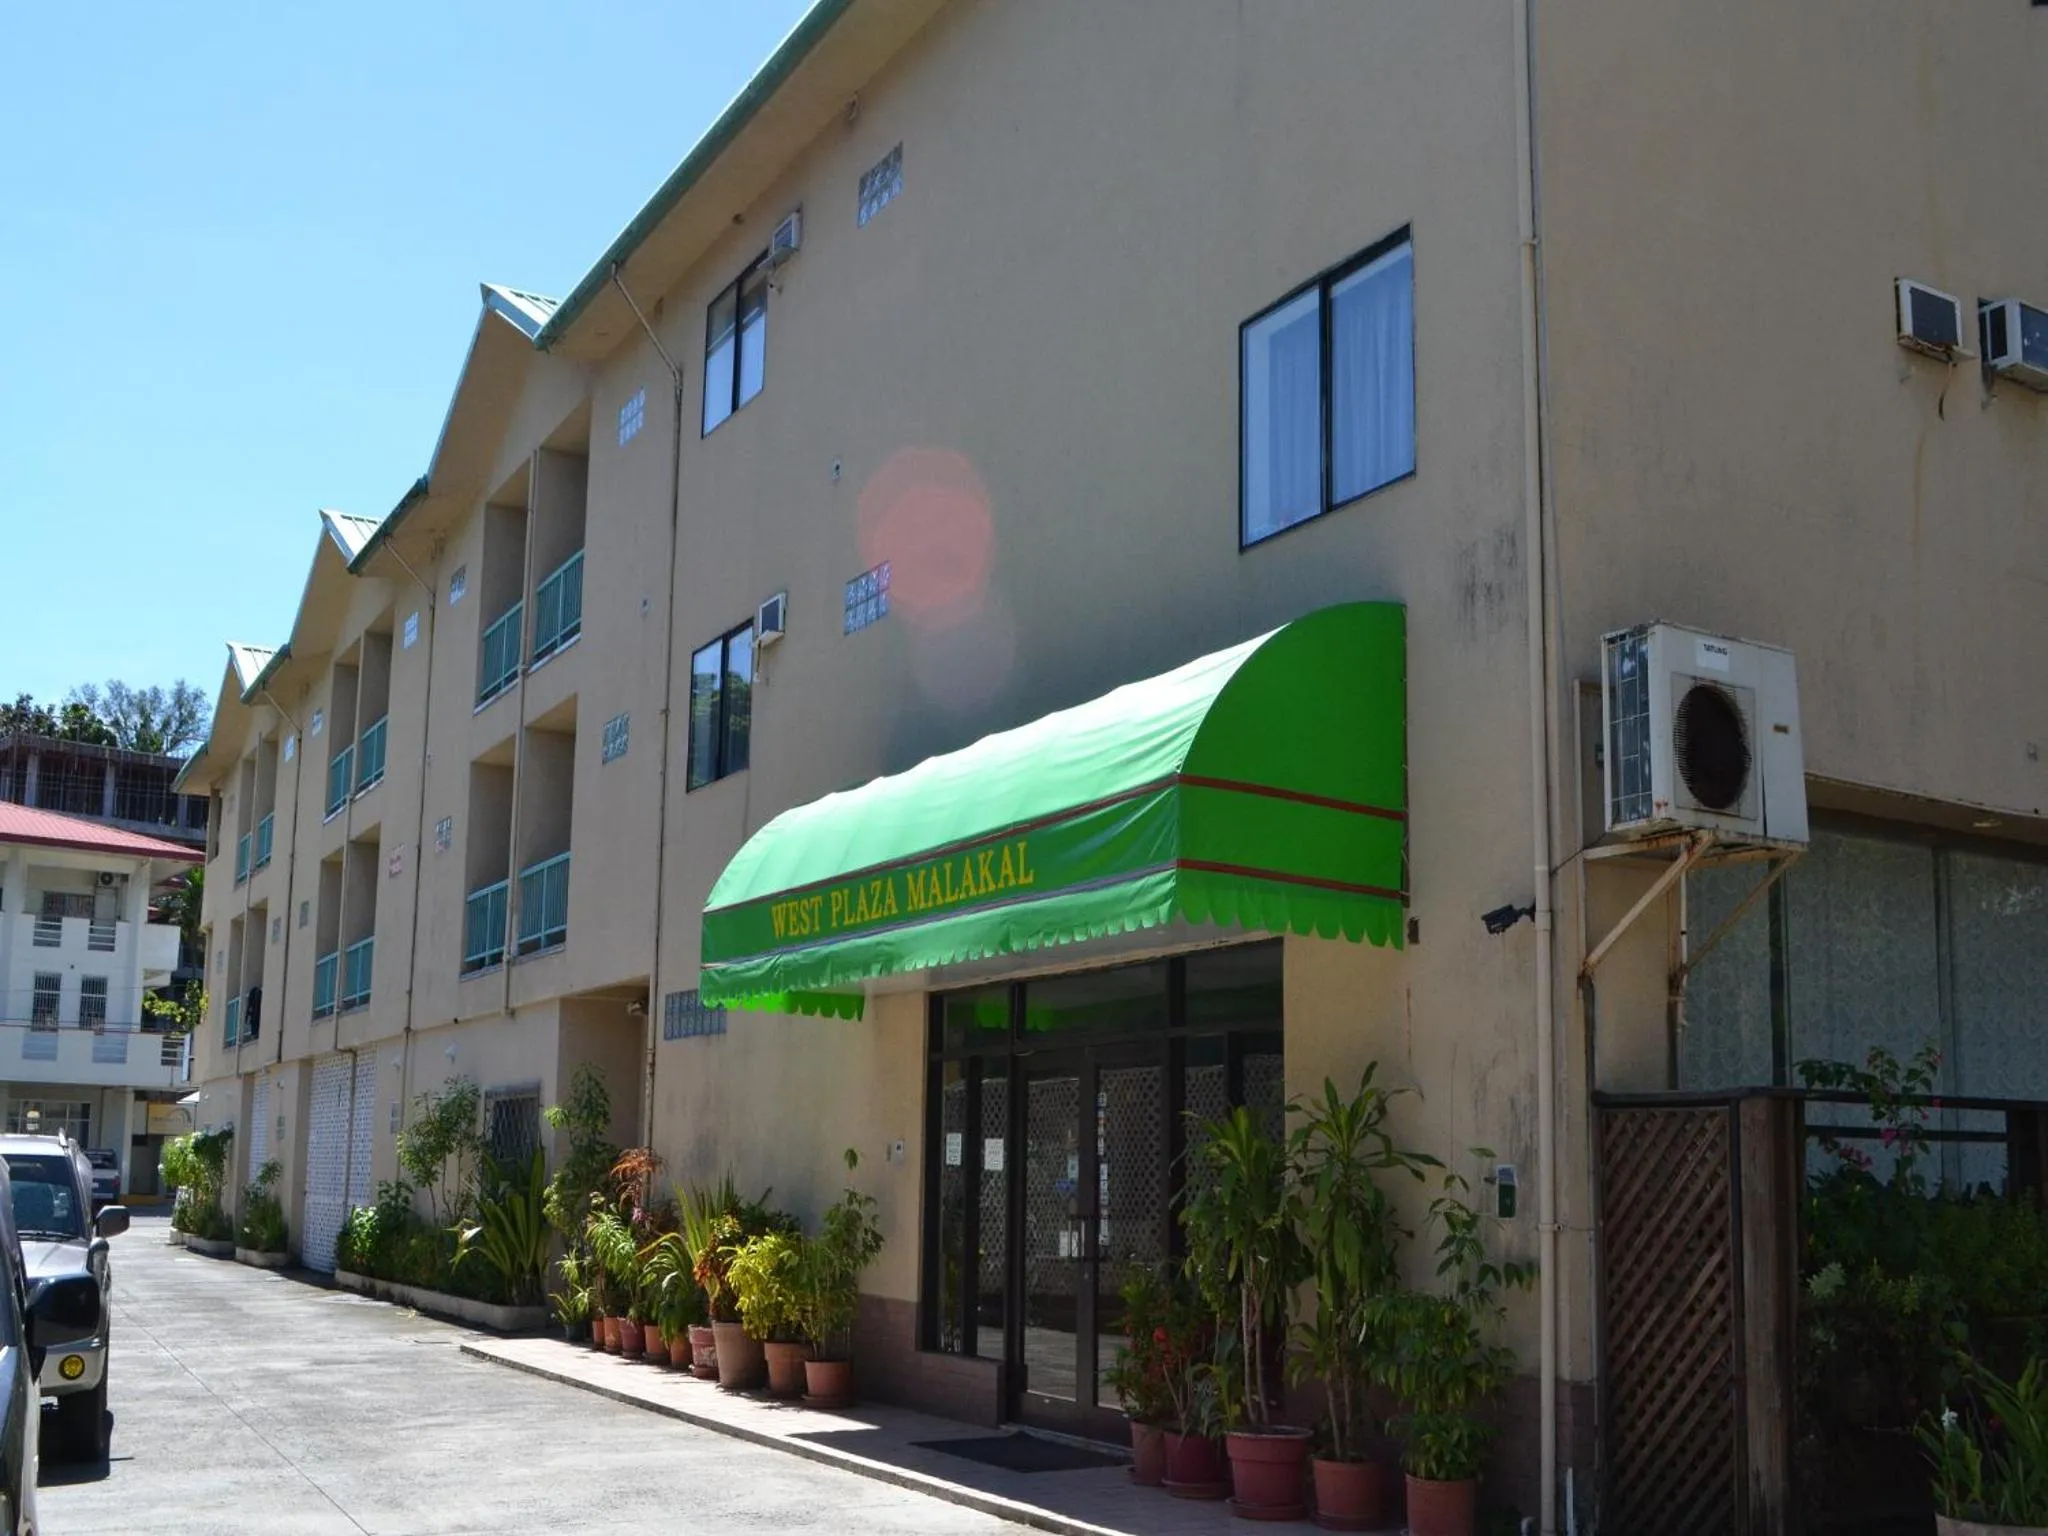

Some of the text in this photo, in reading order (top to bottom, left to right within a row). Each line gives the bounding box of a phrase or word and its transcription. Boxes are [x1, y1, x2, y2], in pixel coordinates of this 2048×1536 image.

[771, 841, 1034, 939] WEST PLAZA MALAKAL
